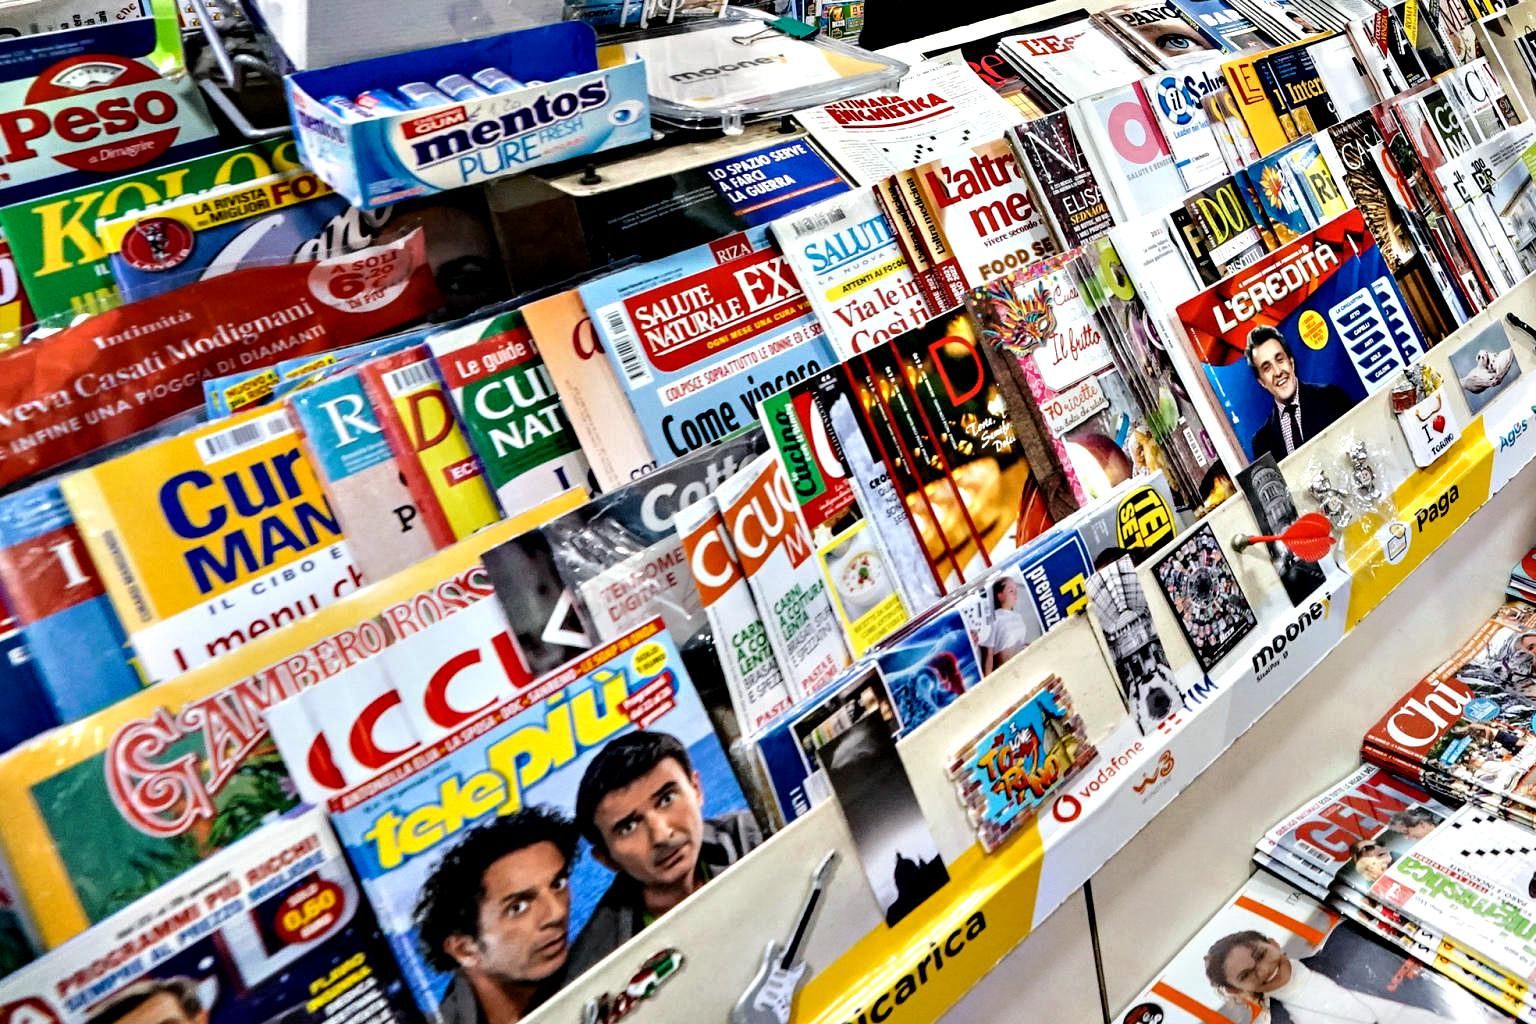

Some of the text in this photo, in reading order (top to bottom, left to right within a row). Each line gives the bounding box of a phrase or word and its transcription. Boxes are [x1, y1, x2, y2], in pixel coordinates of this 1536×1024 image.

[2, 90, 178, 161] Peso
[411, 78, 608, 166] mentos
[459, 118, 582, 182] PURE FRESH
[709, 145, 807, 180] LO SPAZIO SERVE
[213, 188, 267, 211] RIVISTA
[729, 174, 796, 204] LA GUERRA
[731, 171, 766, 189] FARCI
[716, 243, 751, 264] RIZA
[978, 250, 1029, 280] FOOD
[635, 282, 714, 330] SALUTE
[645, 297, 745, 353] NATURALE
[163, 297, 315, 364] Modignani
[1414, 484, 1459, 532] Paga
[1386, 678, 1473, 748] Chi
[1080, 740, 1144, 799] vodafone
